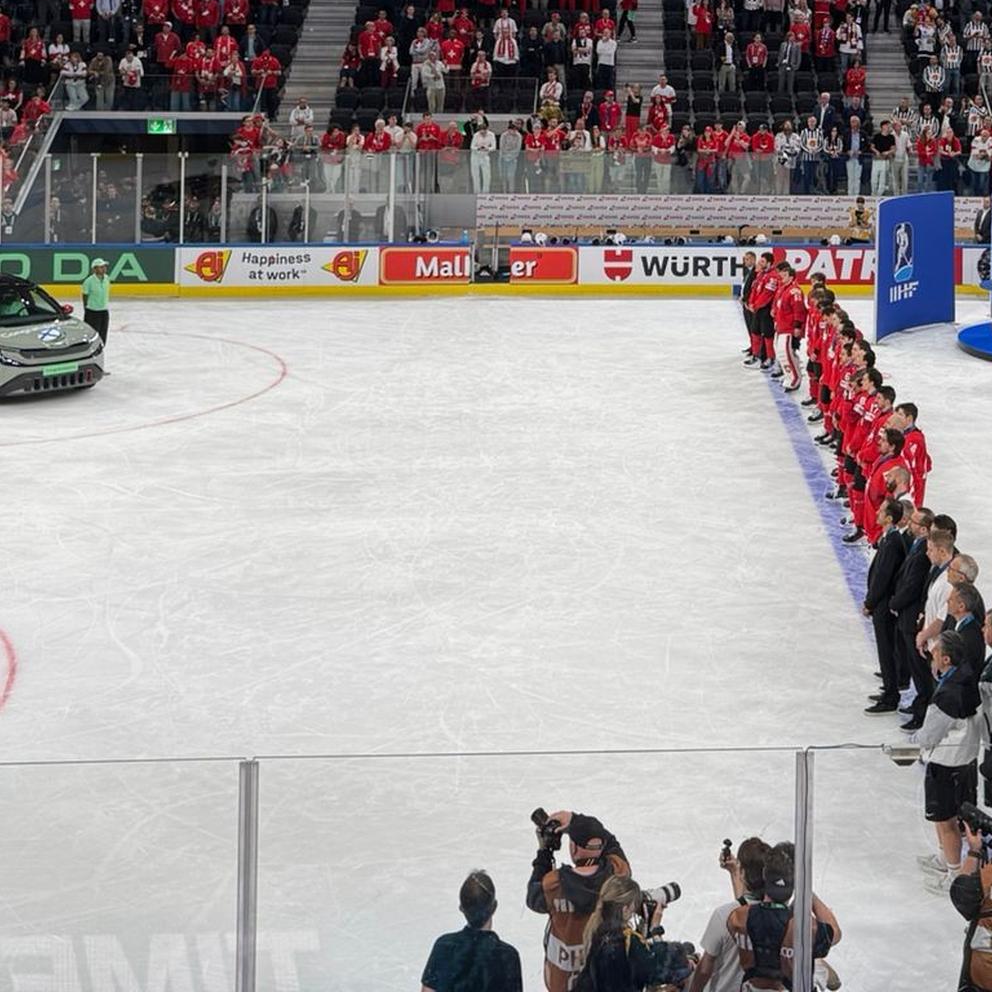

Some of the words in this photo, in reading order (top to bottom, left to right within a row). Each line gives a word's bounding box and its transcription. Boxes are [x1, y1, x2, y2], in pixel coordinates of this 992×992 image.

[242, 251, 312, 267] Happiness
[249, 269, 263, 280] at
[889, 281, 919, 303] IIHF
